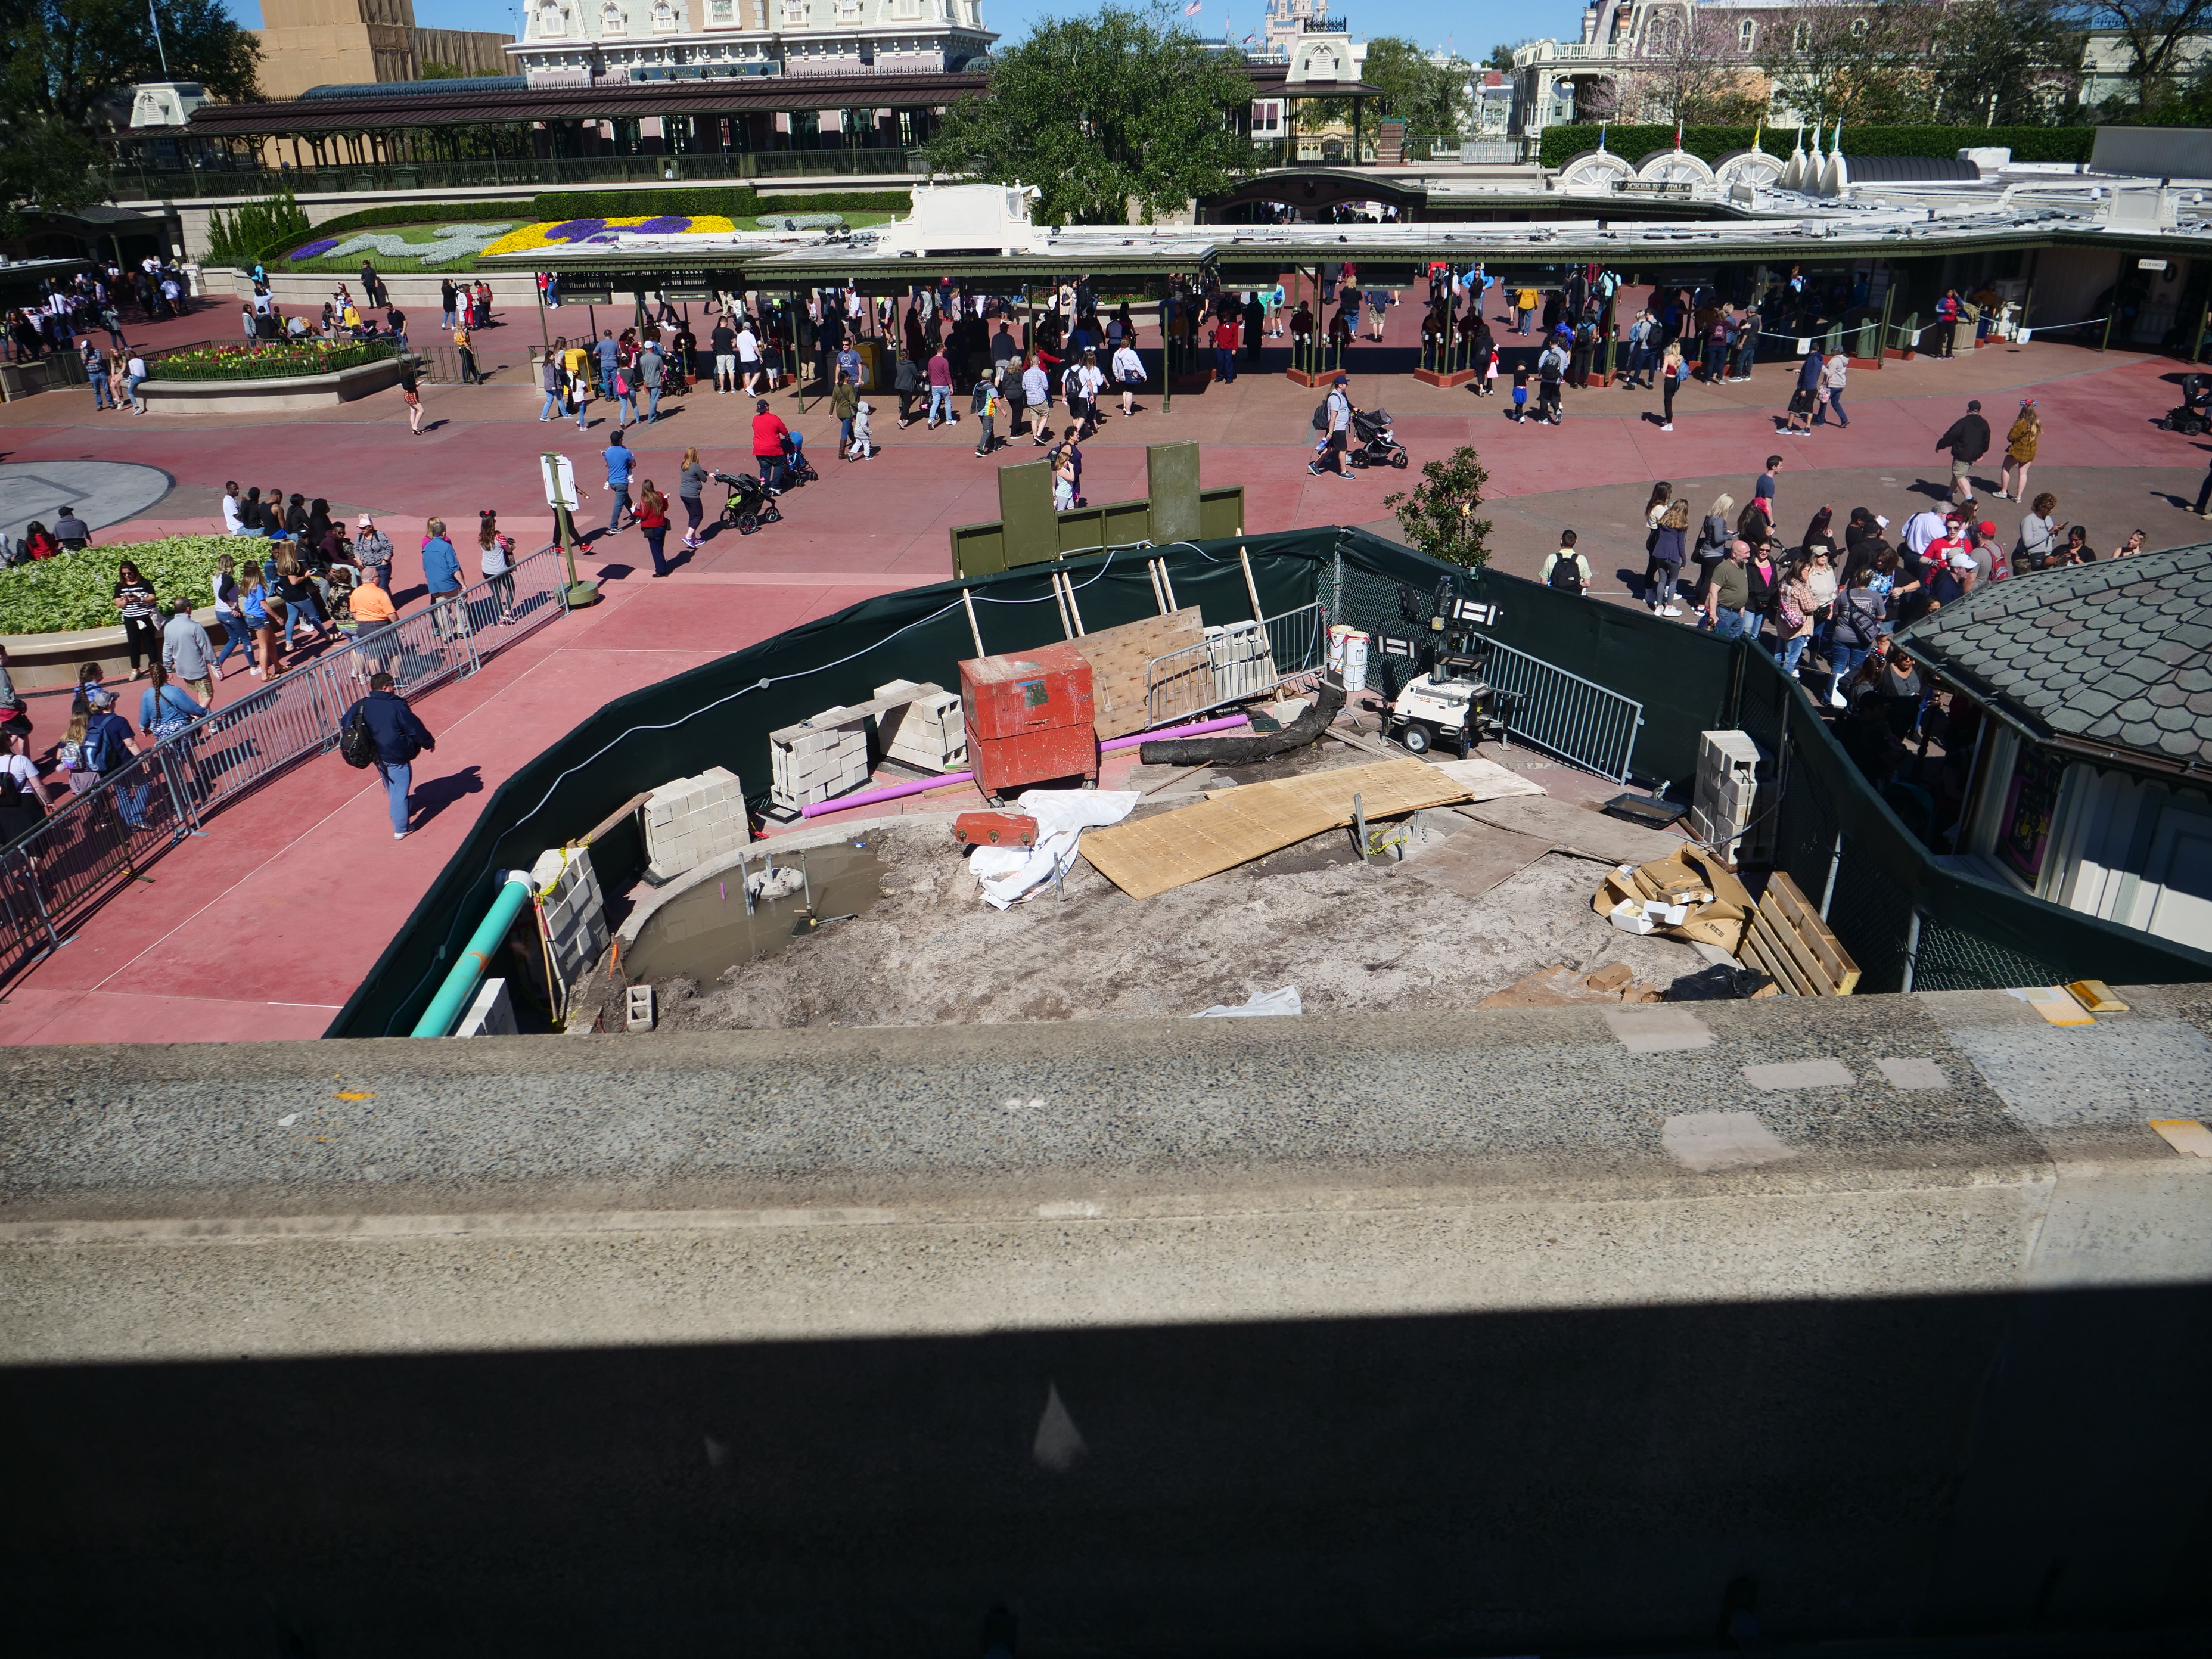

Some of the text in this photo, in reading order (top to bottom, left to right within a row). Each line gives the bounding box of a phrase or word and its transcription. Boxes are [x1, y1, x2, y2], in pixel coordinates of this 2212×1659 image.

[661, 66, 748, 79] MAGIC KINGDOM
[1652, 183, 1683, 191] RENTAL
